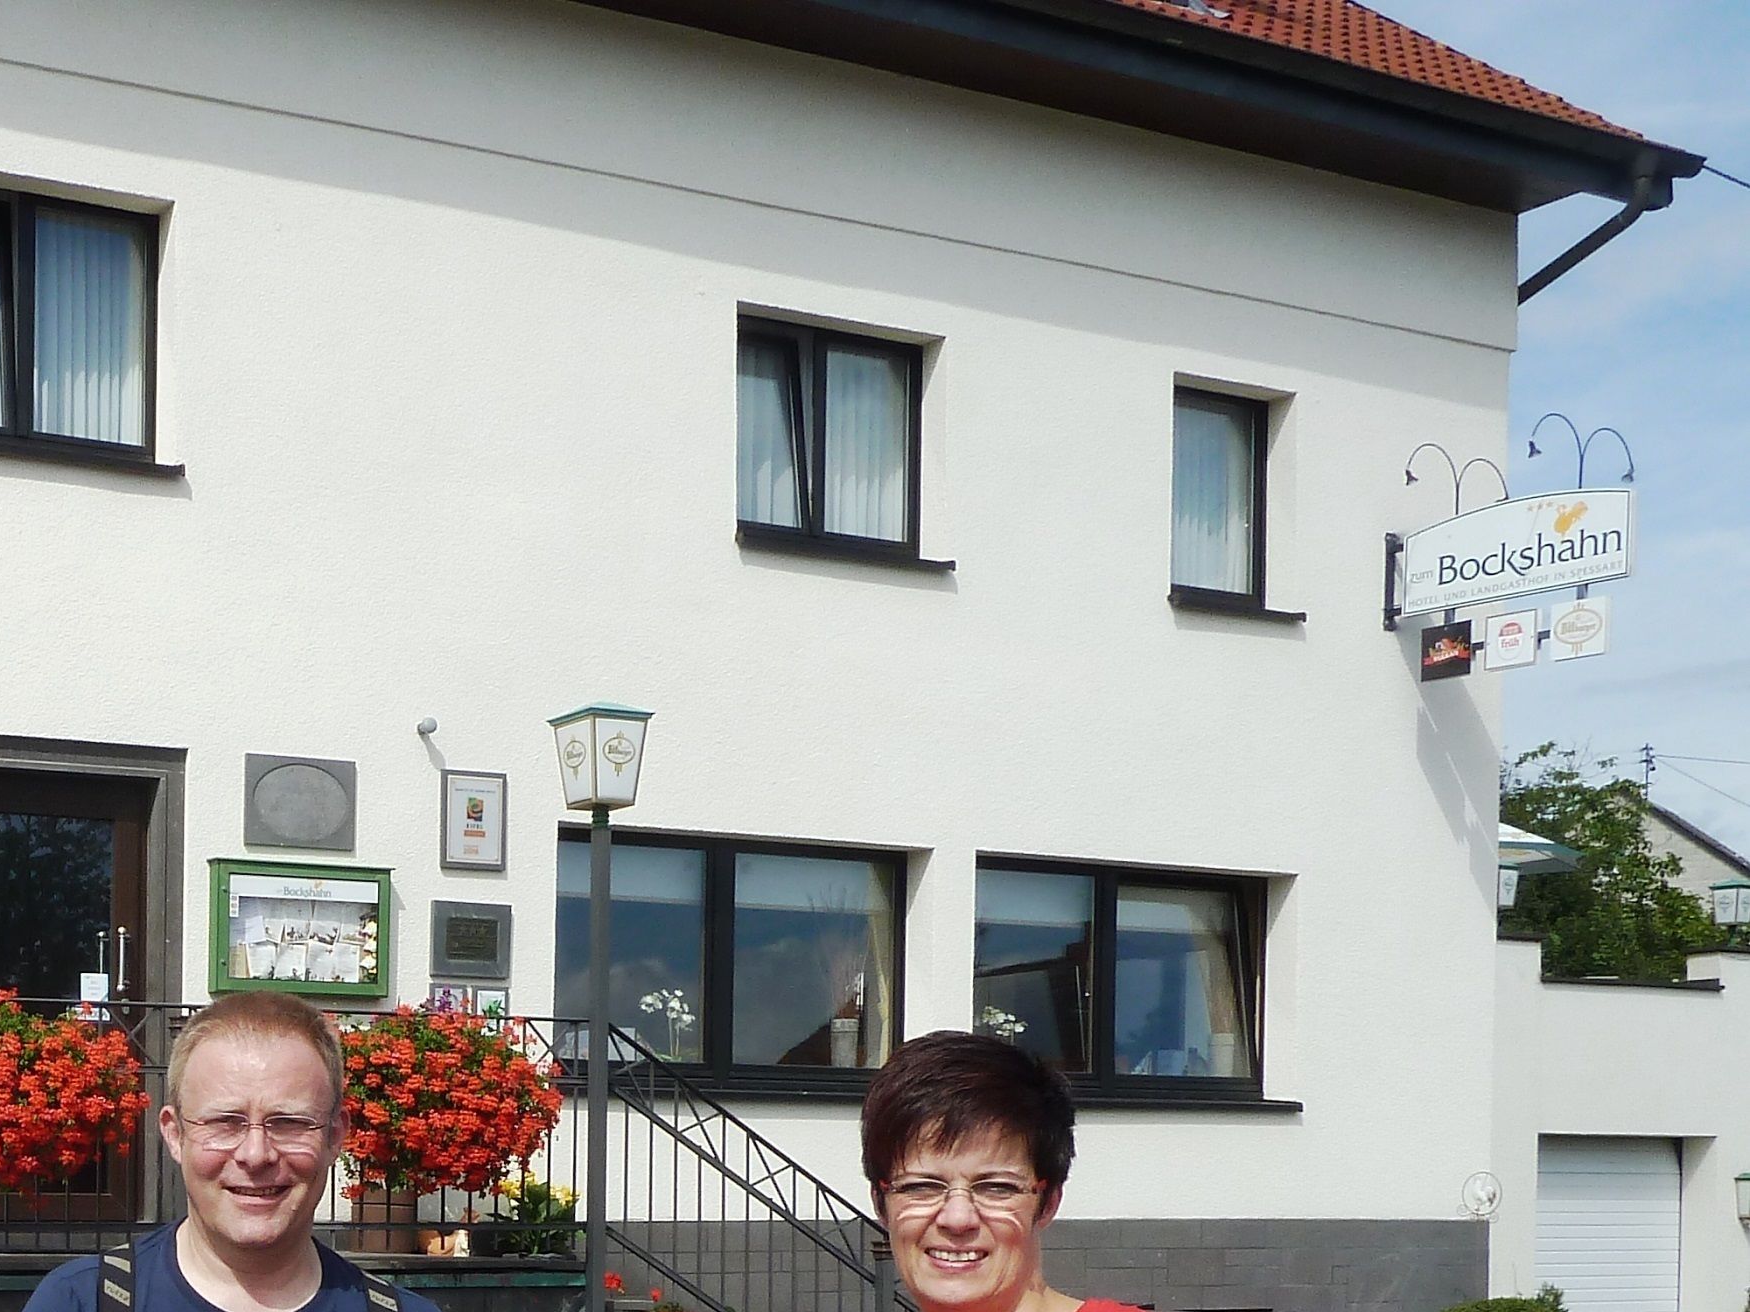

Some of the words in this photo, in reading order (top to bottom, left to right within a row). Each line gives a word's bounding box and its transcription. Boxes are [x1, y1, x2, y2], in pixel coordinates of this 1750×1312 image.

[1409, 569, 1434, 584] zum
[1438, 528, 1622, 585] Bockshahn
[1407, 596, 1438, 608] HOTEL
[1444, 589, 1467, 601] UND
[1470, 575, 1550, 597] LANDGASTHOF
[1554, 572, 1566, 582] IN
